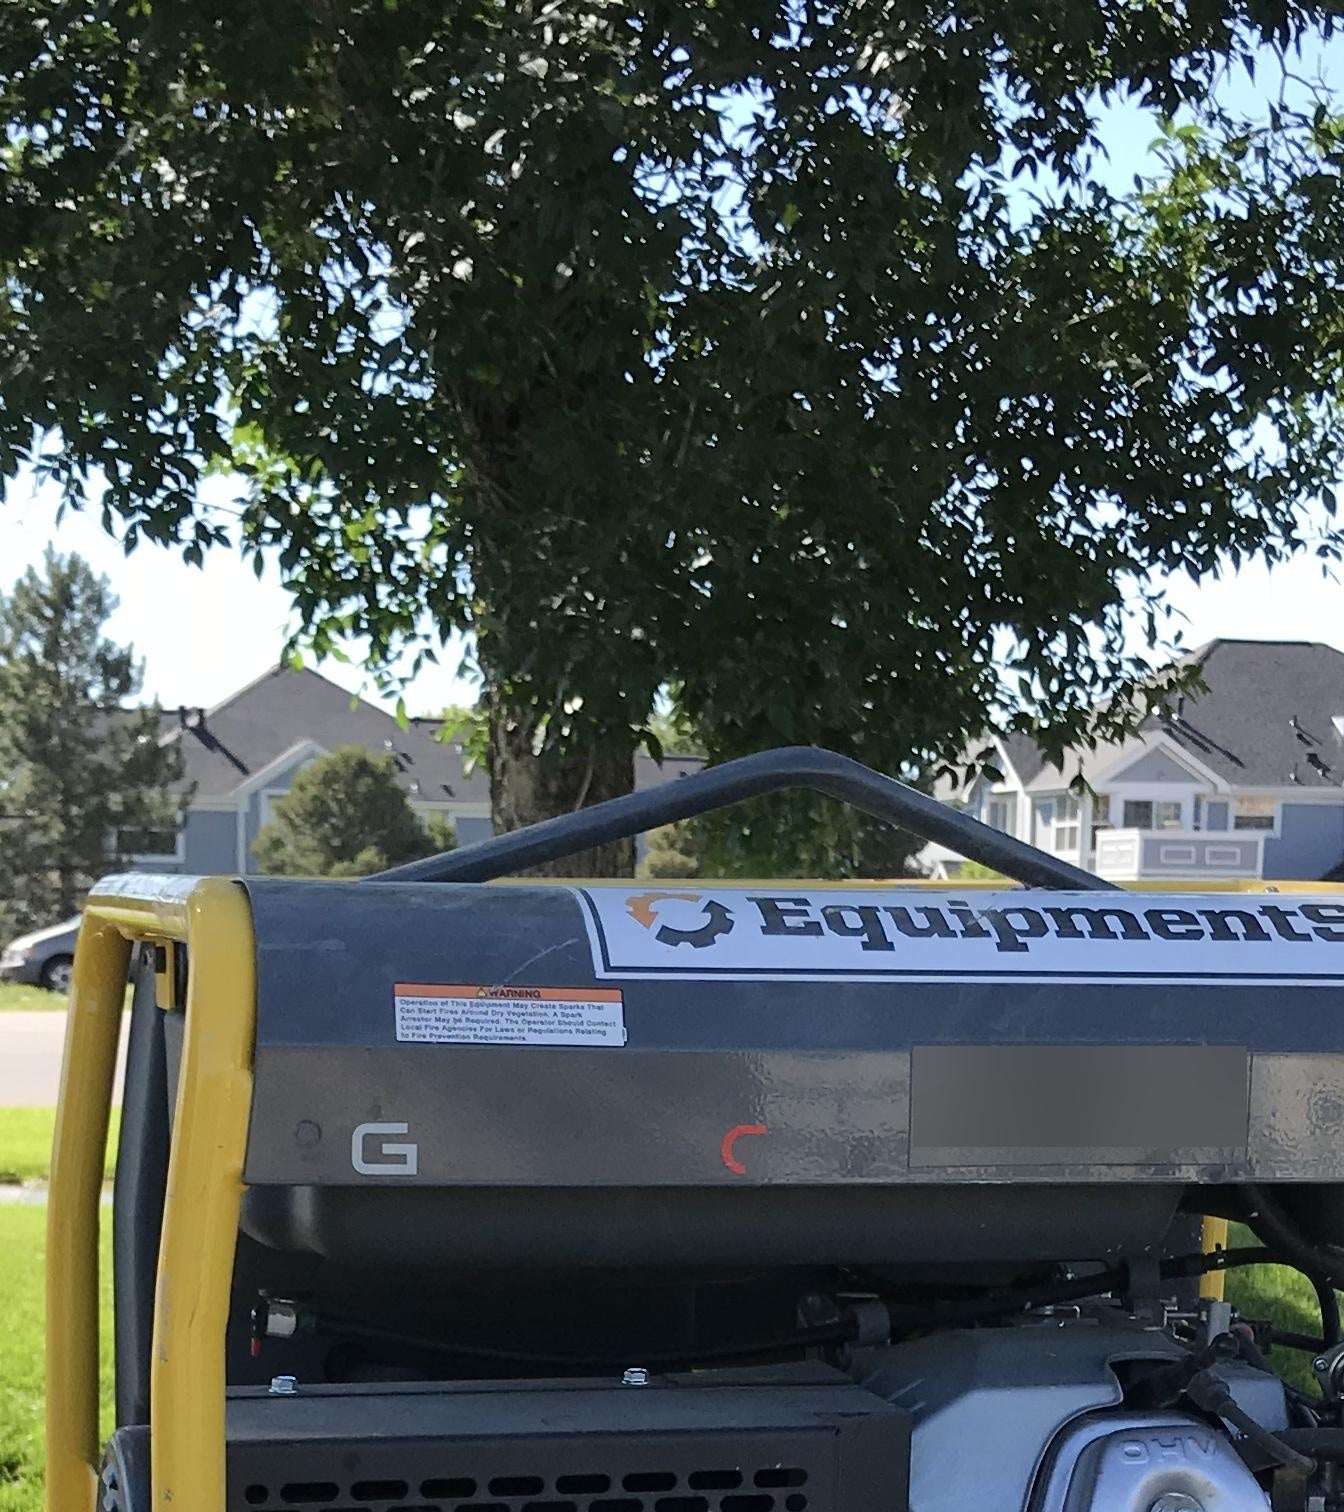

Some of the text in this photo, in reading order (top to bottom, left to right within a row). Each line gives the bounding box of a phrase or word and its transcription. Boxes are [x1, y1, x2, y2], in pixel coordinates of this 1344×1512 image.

[488, 988, 542, 998] WARNING
[400, 999, 438, 1007] Operation
[470, 1001, 511, 1009] Equipment
[513, 1002, 528, 1010] May
[559, 1003, 585, 1011] Sparks
[527, 1027, 573, 1035] Regulations
[575, 1028, 607, 1036] Relating
[351, 1122, 418, 1175] G
[1119, 1436, 1218, 1464] OHV
